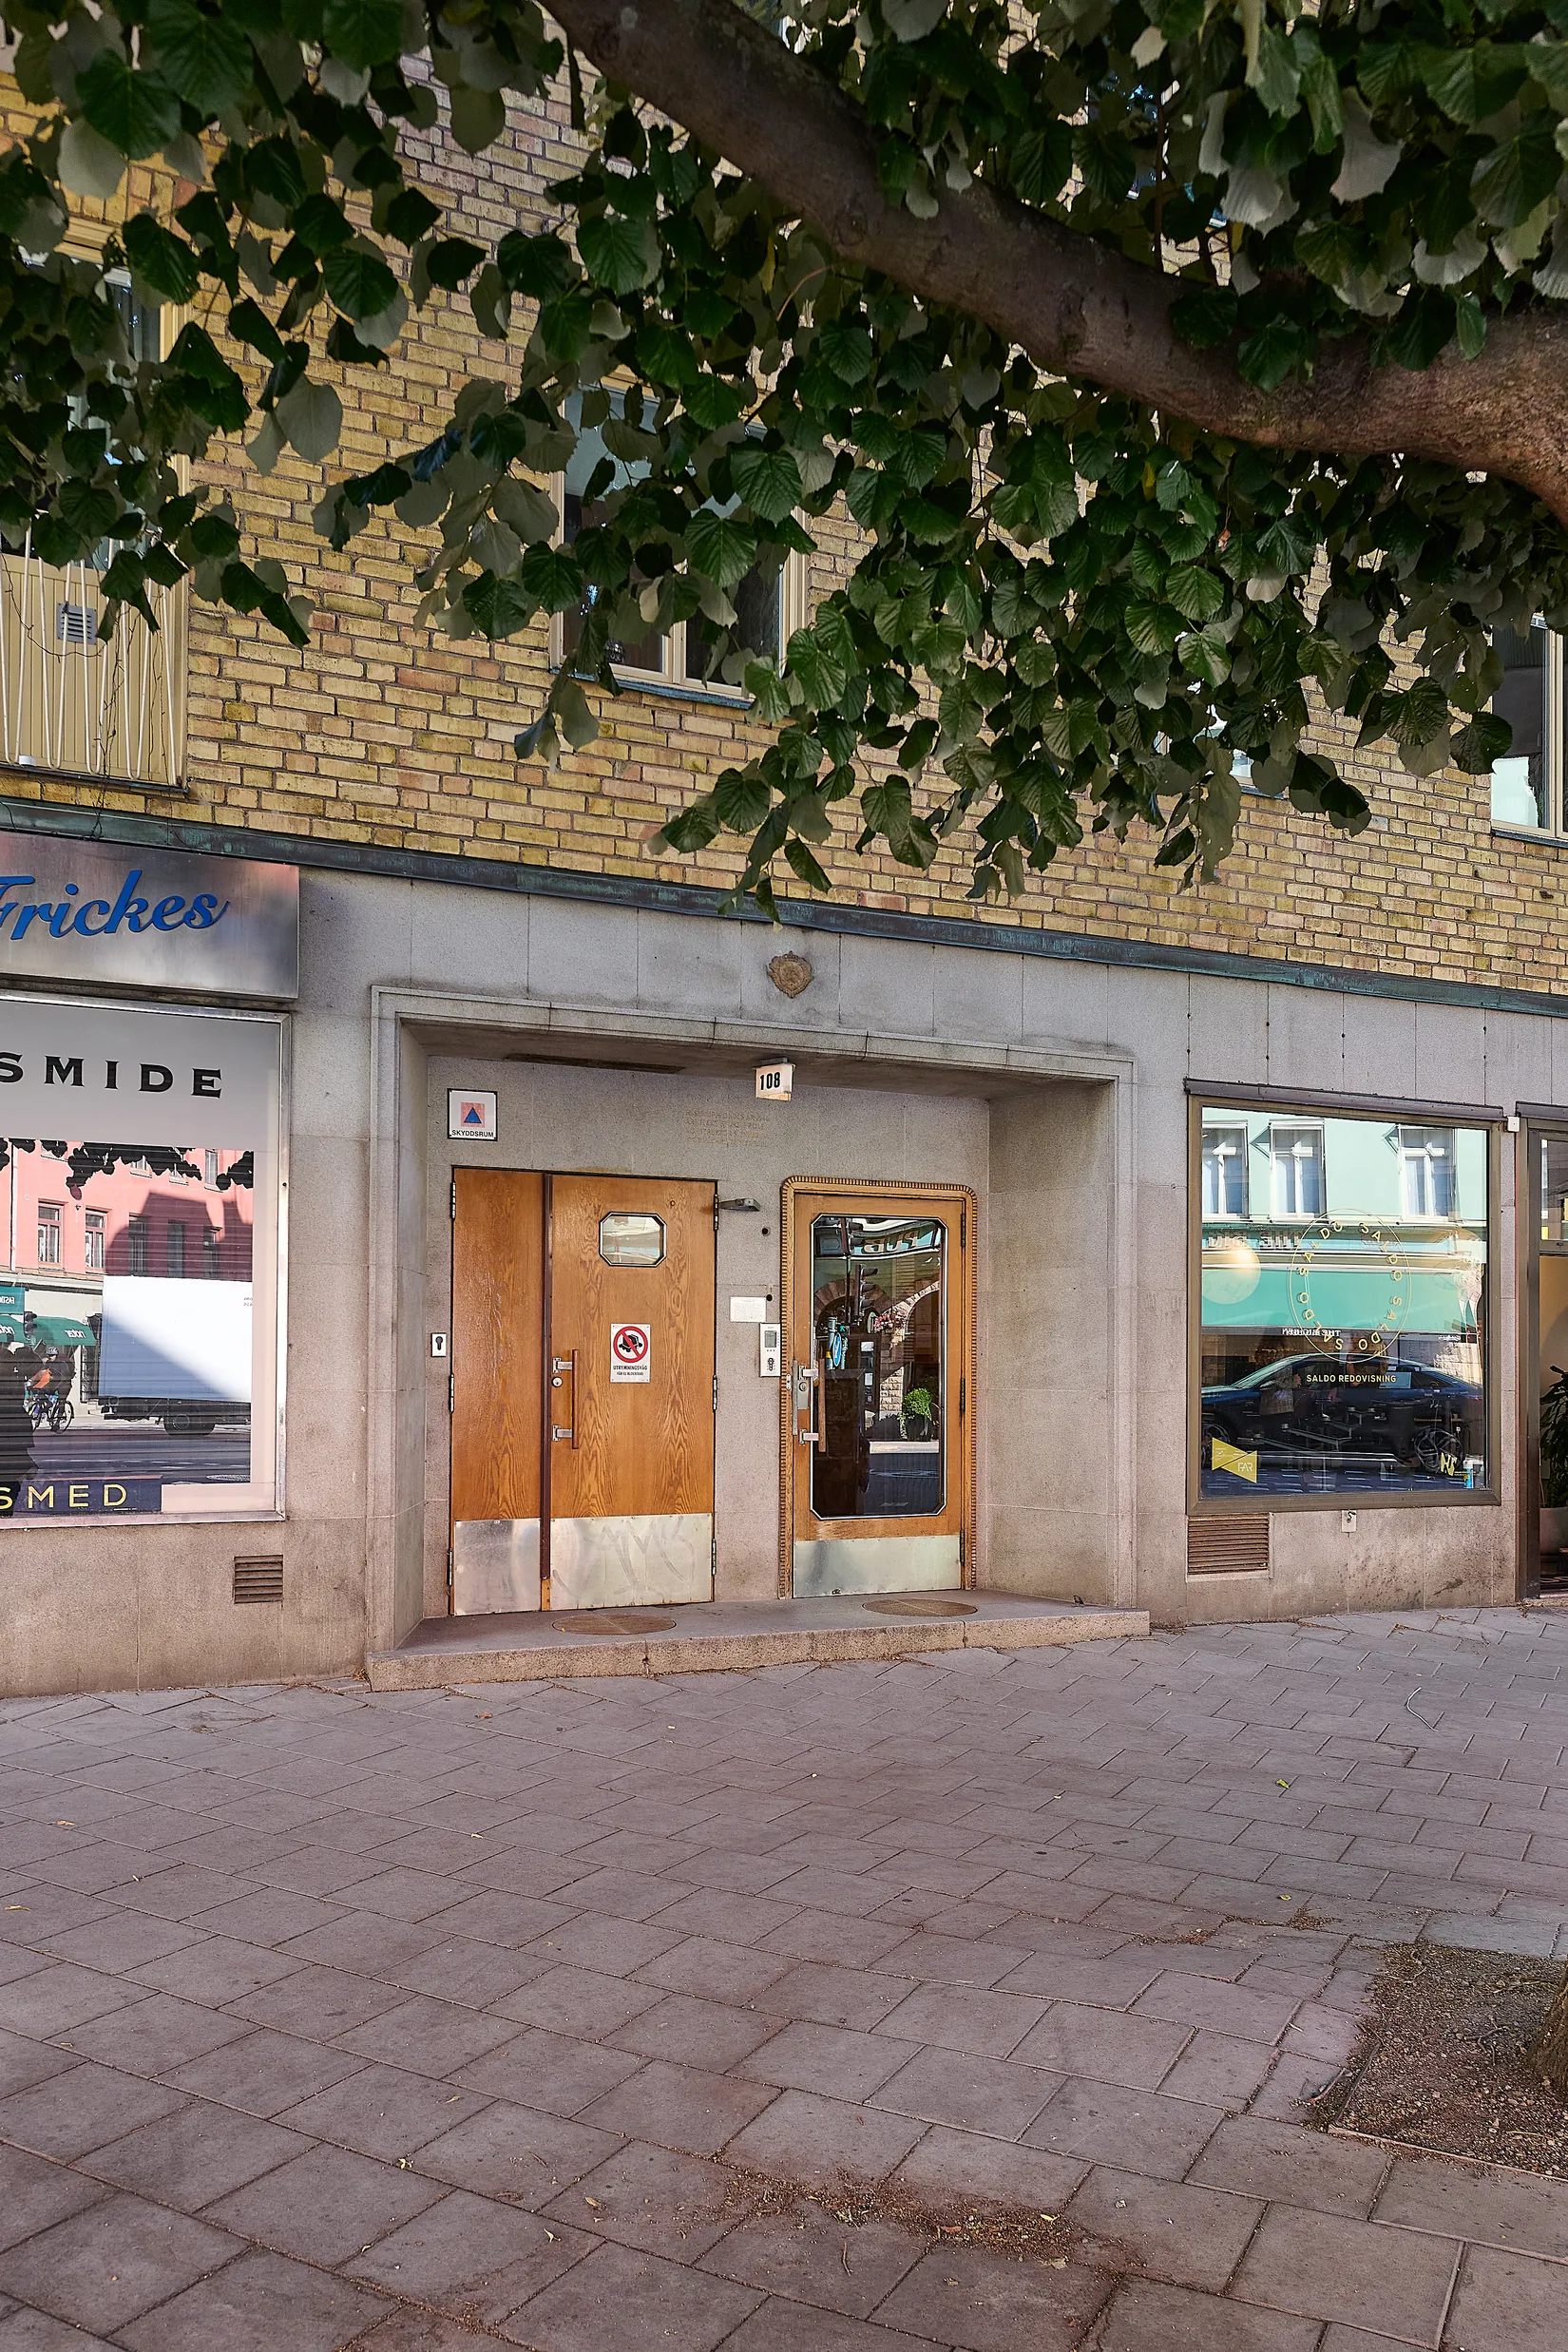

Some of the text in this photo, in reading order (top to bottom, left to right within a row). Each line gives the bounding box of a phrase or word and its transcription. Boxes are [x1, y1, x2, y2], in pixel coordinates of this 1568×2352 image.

[0, 1051, 222, 1099] SMIDE
[760, 1072, 780, 1090] 108
[1299, 1220, 1343, 1277] SALDO
[1360, 1222, 1403, 1281] SALDO
[1299, 1291, 1344, 1350] SALDO
[1358, 1295, 1403, 1350] SALDO
[1306, 1374, 1397, 1383] SALDO REDOVISNING
[1238, 1463, 1253, 1472] FAR
[0, 1483, 127, 1509] SMED
